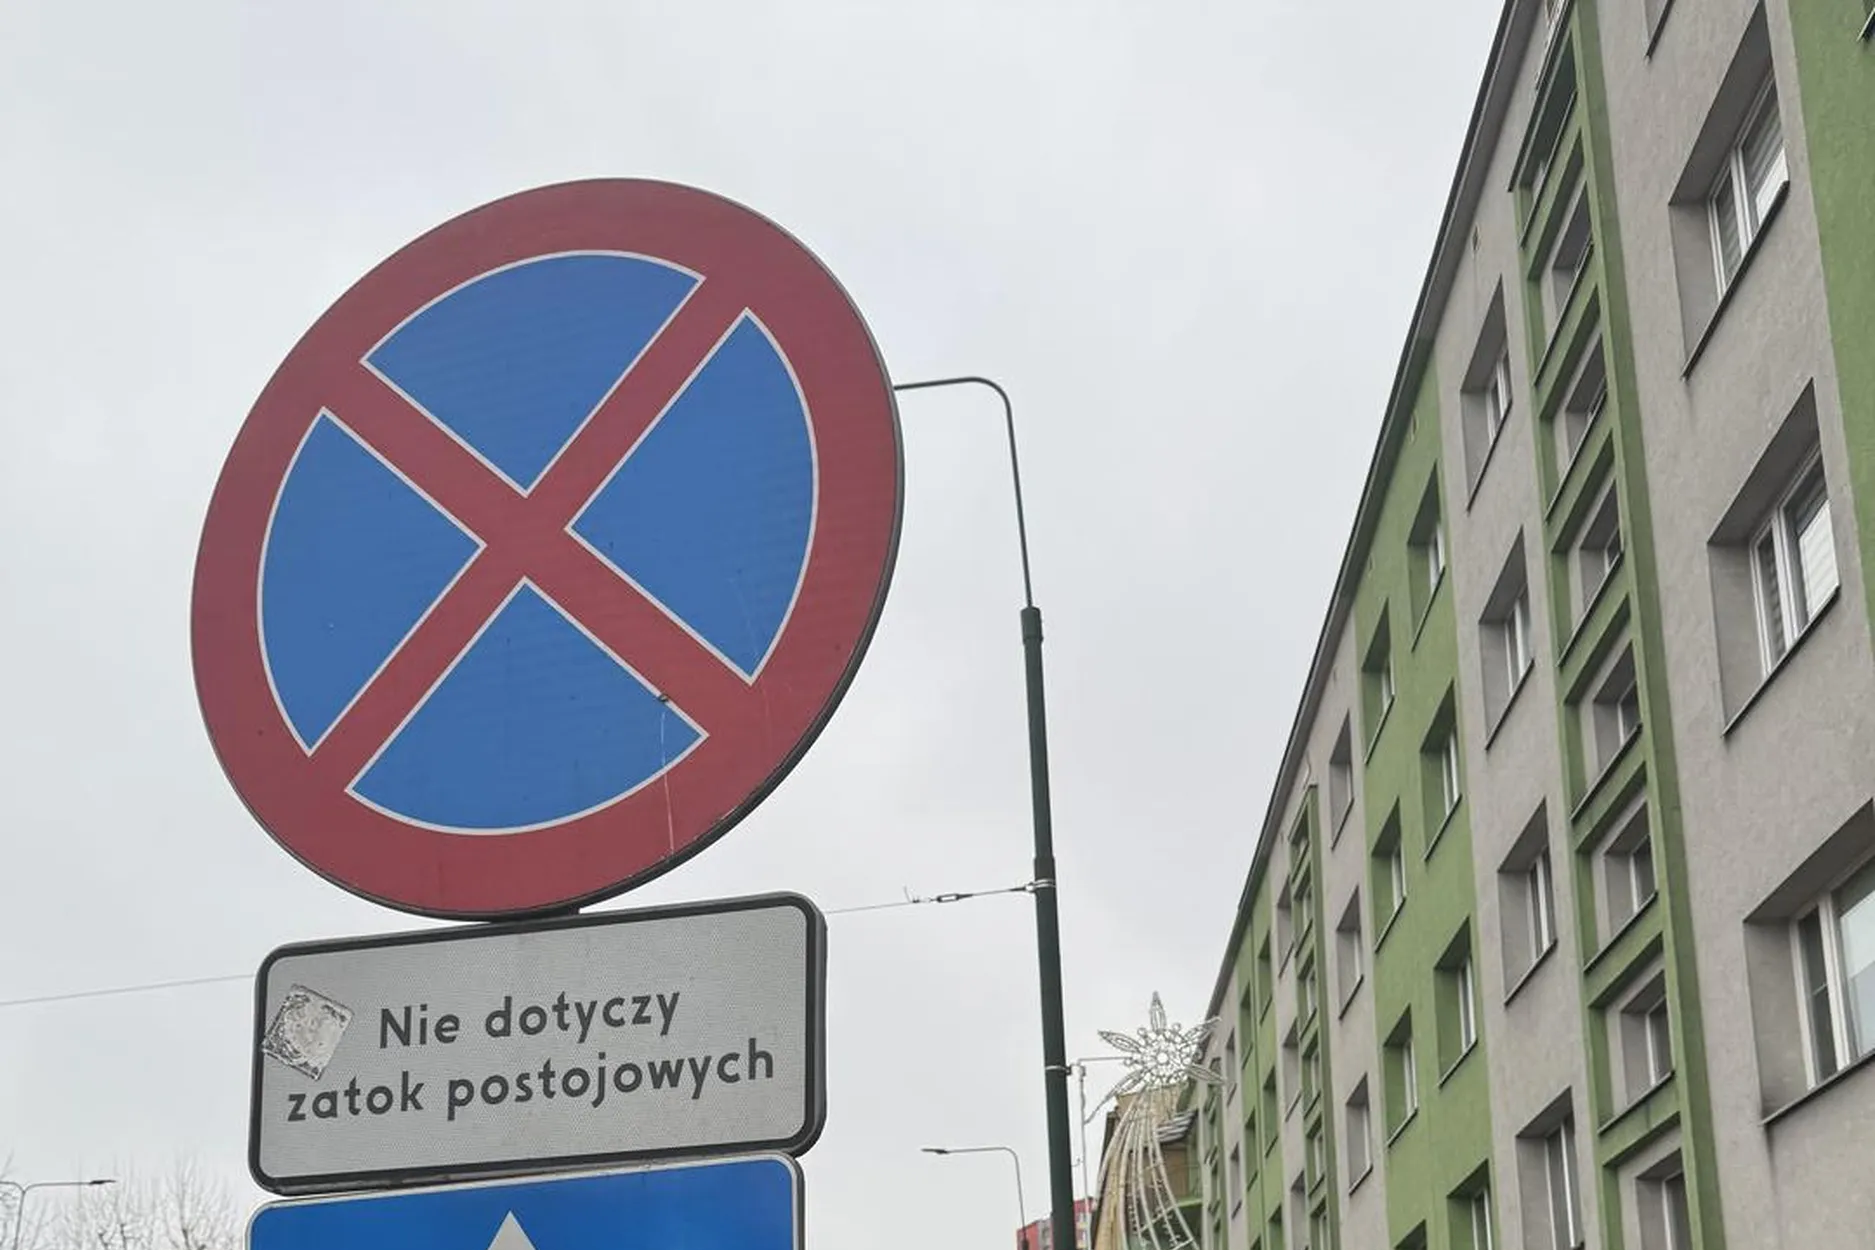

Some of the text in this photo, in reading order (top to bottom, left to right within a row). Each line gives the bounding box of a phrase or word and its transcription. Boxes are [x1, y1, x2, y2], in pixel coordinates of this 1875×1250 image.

[379, 991, 680, 1049] Nie dotyczy
[288, 1037, 774, 1122] zatok postojowych
